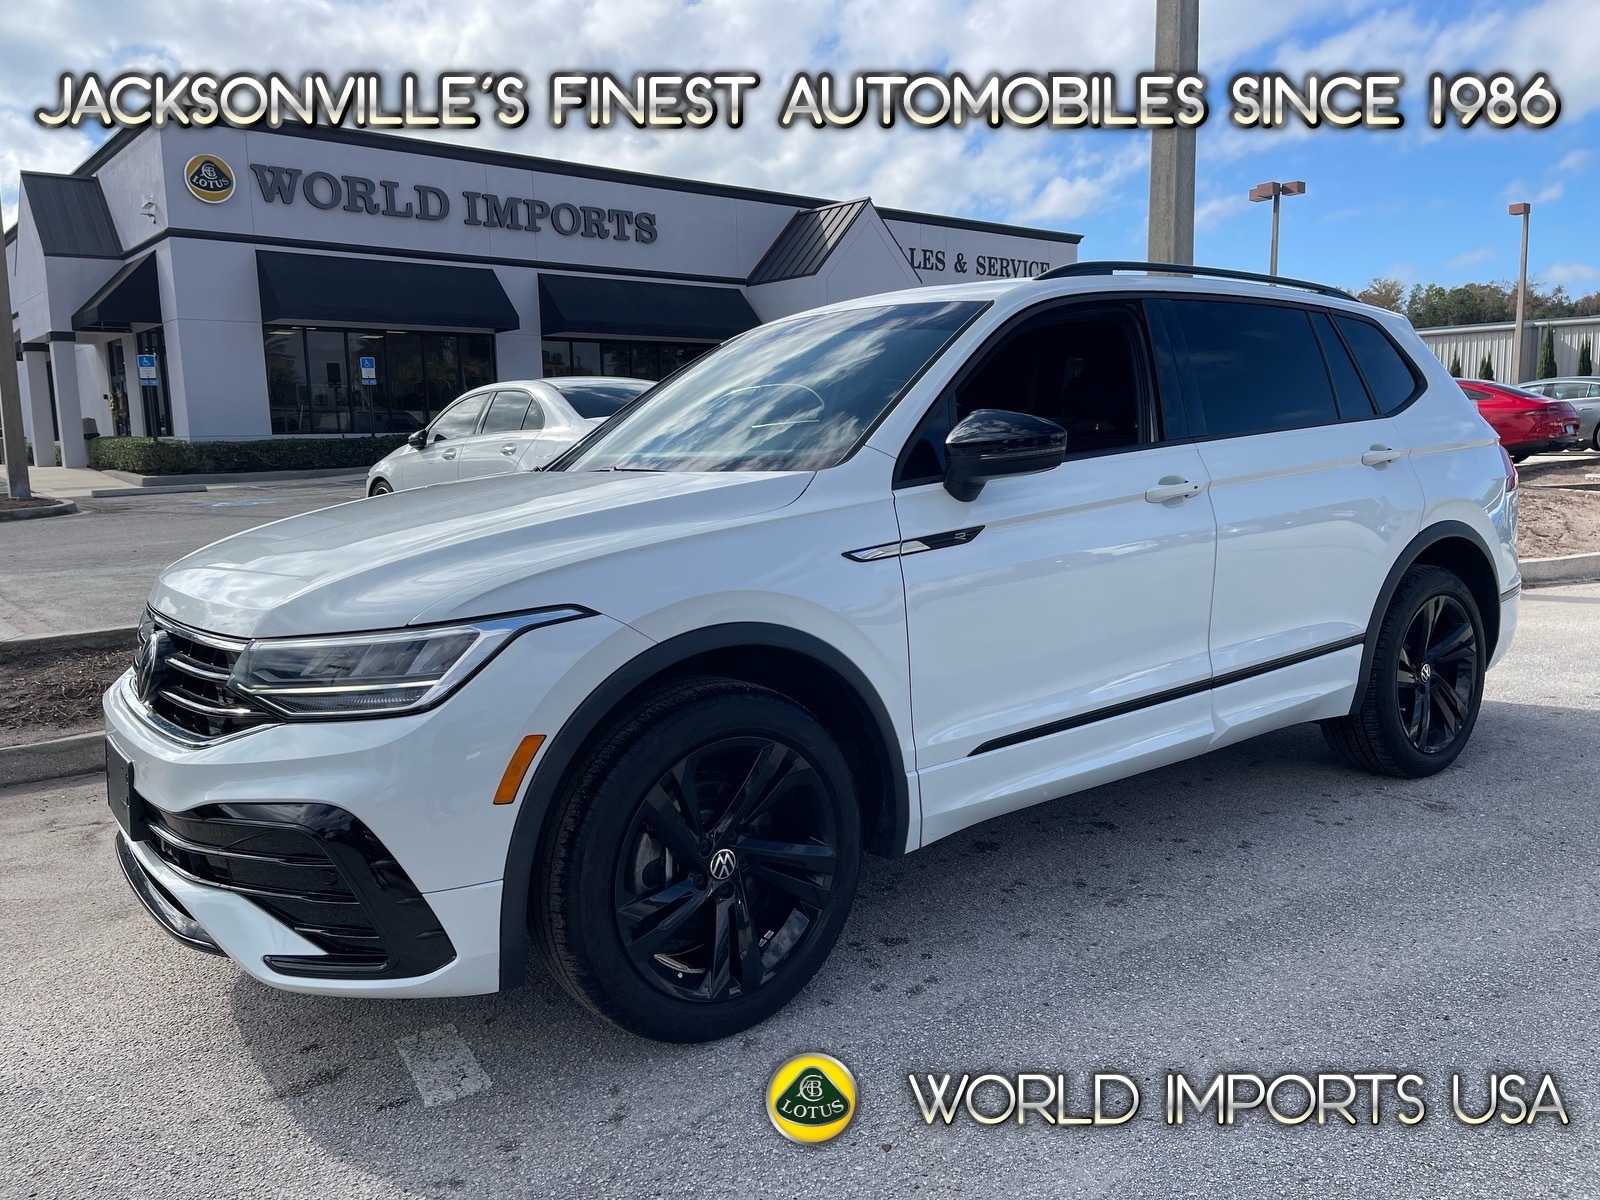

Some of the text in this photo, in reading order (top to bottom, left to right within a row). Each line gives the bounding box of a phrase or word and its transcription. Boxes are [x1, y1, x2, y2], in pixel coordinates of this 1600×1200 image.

[192, 175, 230, 189] LOTUS
[250, 163, 658, 244] WORLD IMPORTS
[907, 247, 946, 272] LES
[976, 255, 1050, 279] SERVICE
